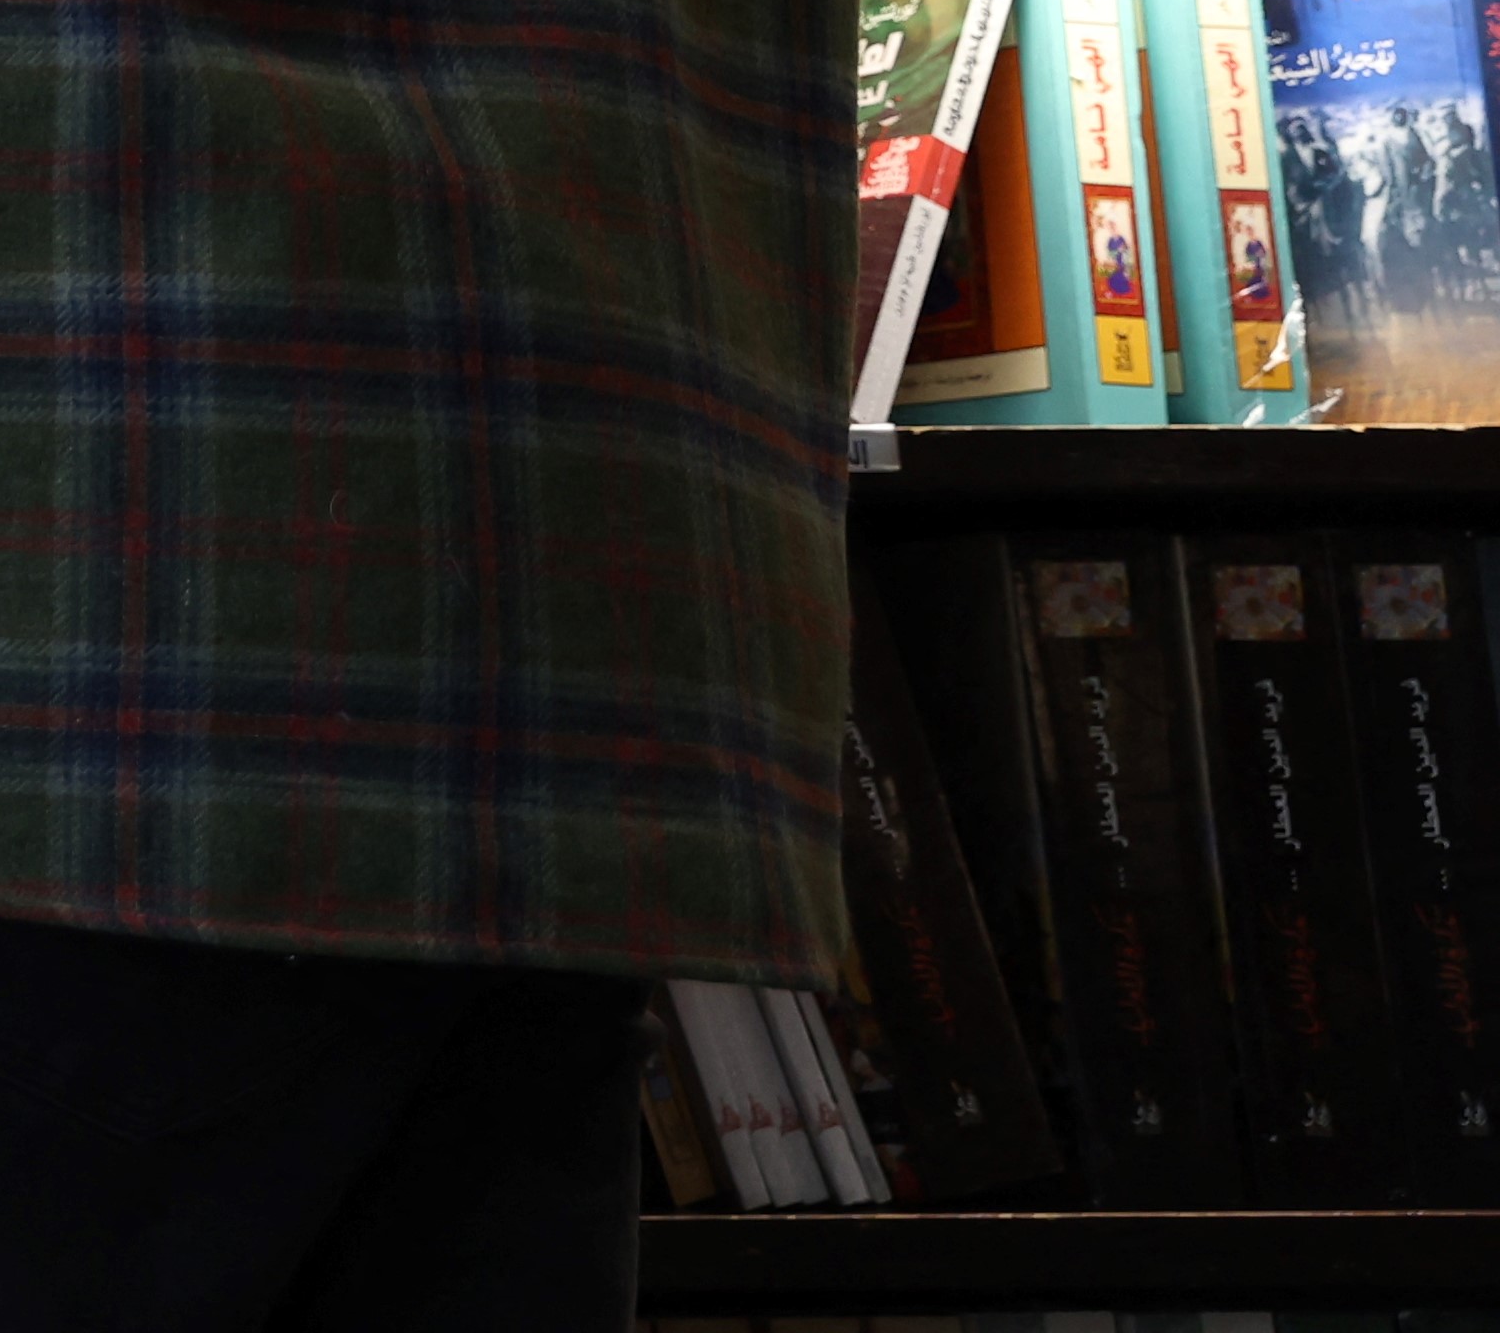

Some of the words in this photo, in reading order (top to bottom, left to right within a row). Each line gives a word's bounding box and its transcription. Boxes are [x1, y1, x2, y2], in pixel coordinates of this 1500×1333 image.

[1253, 677, 1283, 723] فريد
[1261, 727, 1292, 779] الدين
[1268, 783, 1302, 850] العطار
